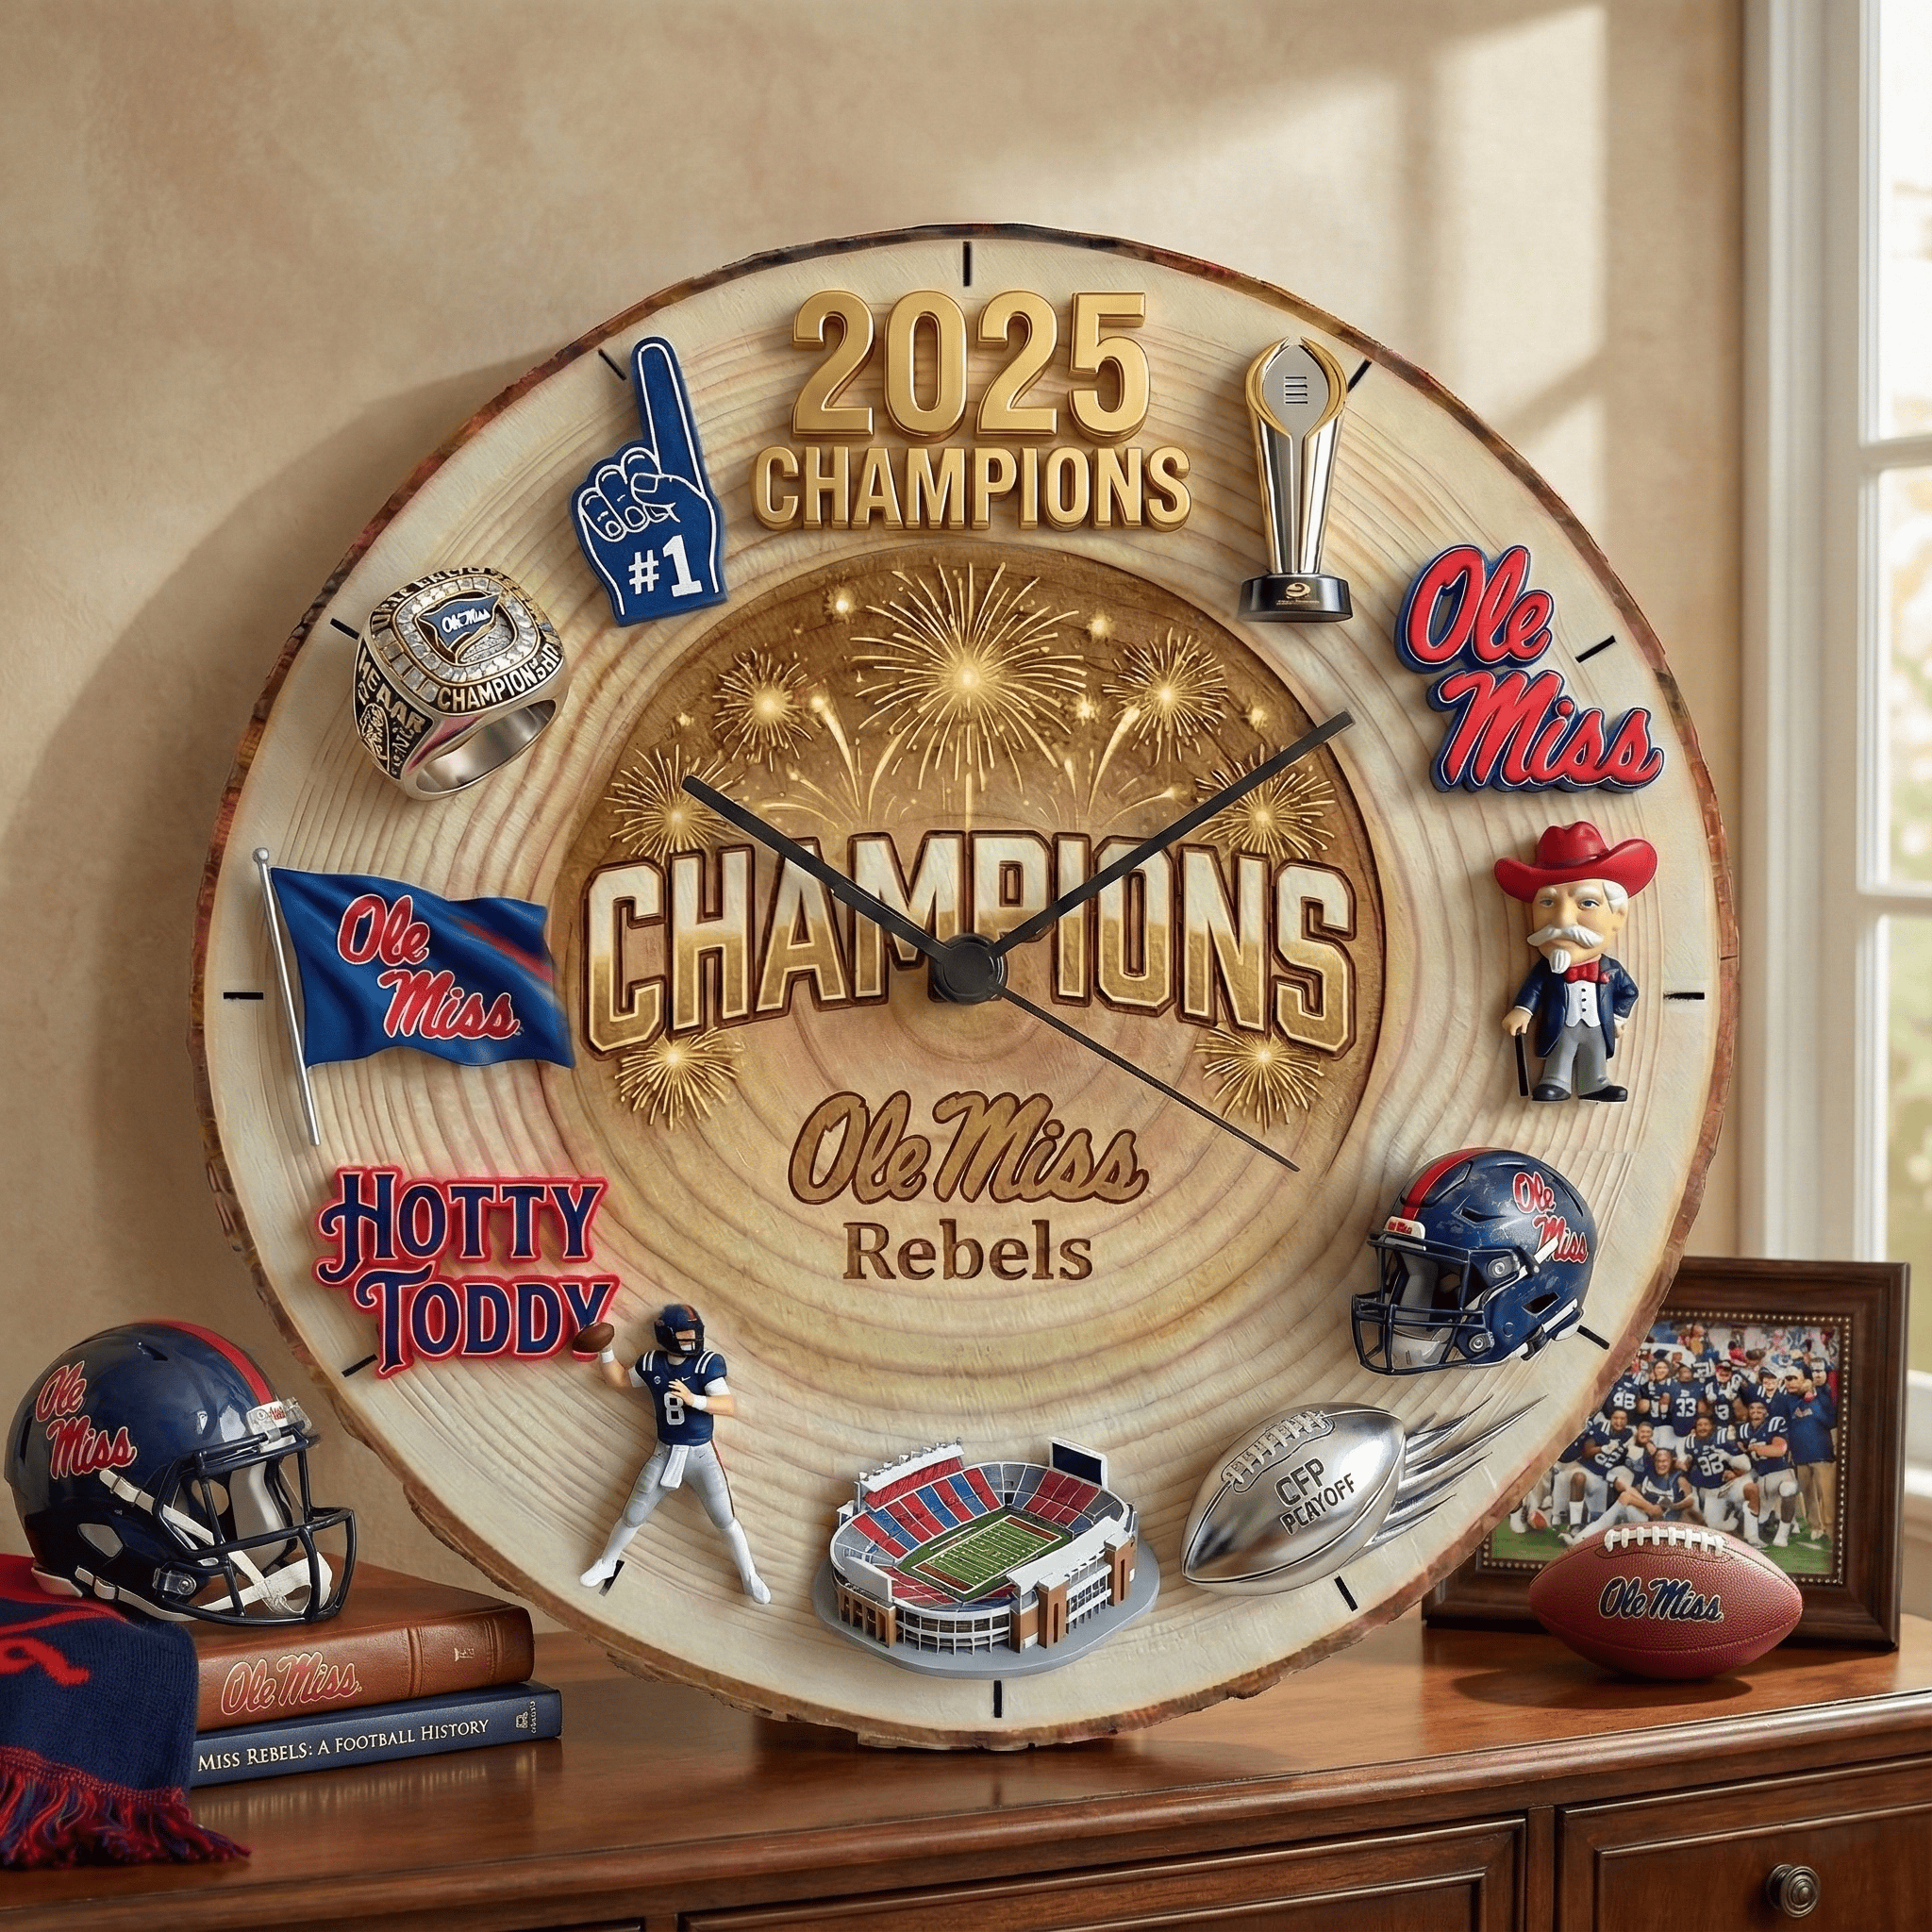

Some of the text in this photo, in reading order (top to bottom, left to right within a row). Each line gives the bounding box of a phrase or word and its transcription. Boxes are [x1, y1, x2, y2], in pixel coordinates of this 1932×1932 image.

[792, 291, 1150, 443] 2025
[756, 446, 1192, 532] CHAMPIONS
[628, 535, 703, 597] #1
[1396, 544, 1555, 671] Ole
[1427, 669, 1664, 791] Miss
[338, 893, 430, 966] Ole
[580, 829, 1357, 1059] CHAMPIONS
[377, 969, 521, 1040] Miss
[788, 1091, 1149, 1205] Ole Miss
[1513, 1171, 1557, 1214] Ole
[314, 1167, 607, 1286] HOTTY
[842, 1218, 1092, 1281] Rebels
[1532, 1214, 1589, 1264] Miss
[353, 1260, 618, 1378] TODDY
[36, 1360, 87, 1423] Ole
[664, 1391, 685, 1425] 8
[47, 1415, 137, 1479] Miss
[1274, 1457, 1324, 1507] CFP
[1599, 1576, 1724, 1623] Ole Miss
[222, 1651, 360, 1715] Ole Miss
[197, 1719, 490, 1773] MISS REBELS: A FOOTBALL HISTORY
